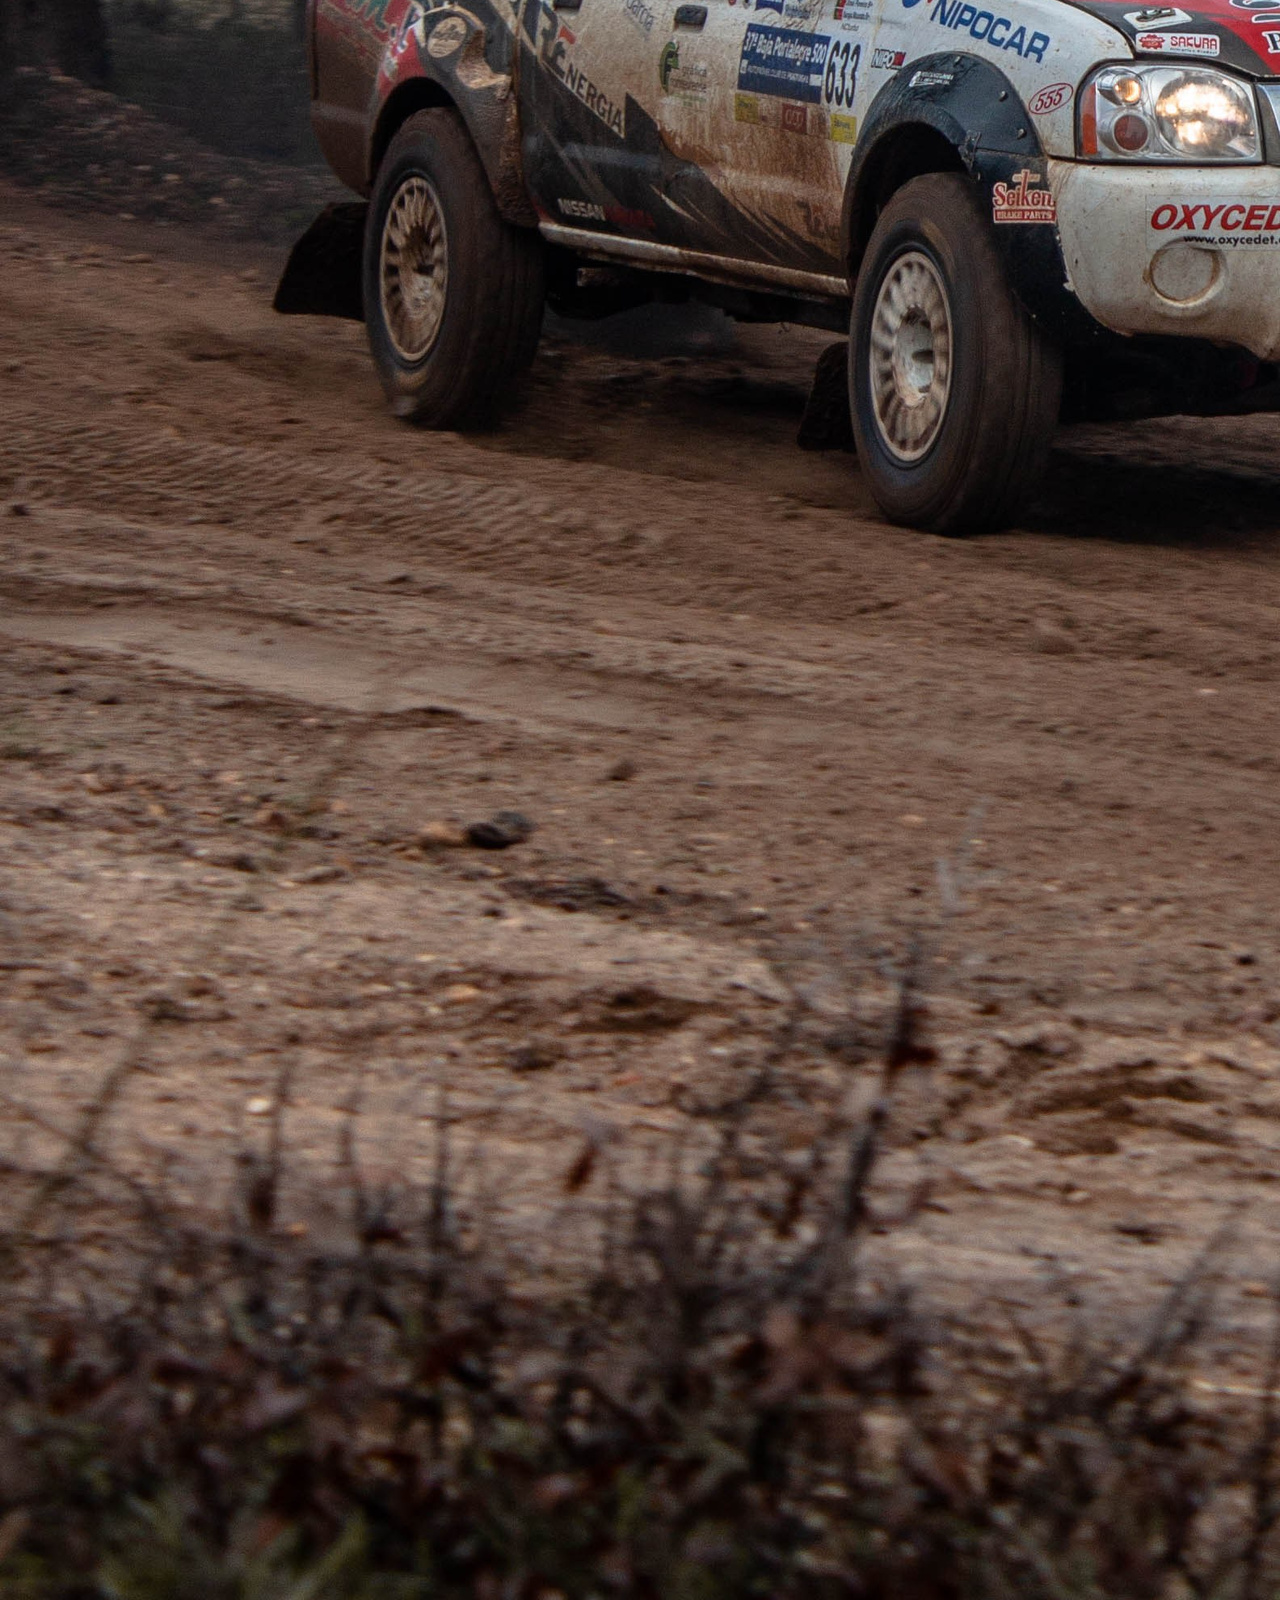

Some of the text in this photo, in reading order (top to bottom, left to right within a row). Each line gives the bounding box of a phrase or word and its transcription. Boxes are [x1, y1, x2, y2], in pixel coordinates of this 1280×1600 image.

[811, 43, 828, 64] 500
[1170, 36, 1218, 50] SAKURA
[825, 40, 861, 108] 633
[1034, 86, 1067, 112] 555
[994, 171, 1056, 208] Seiken
[1024, 210, 1052, 220] PARTS
